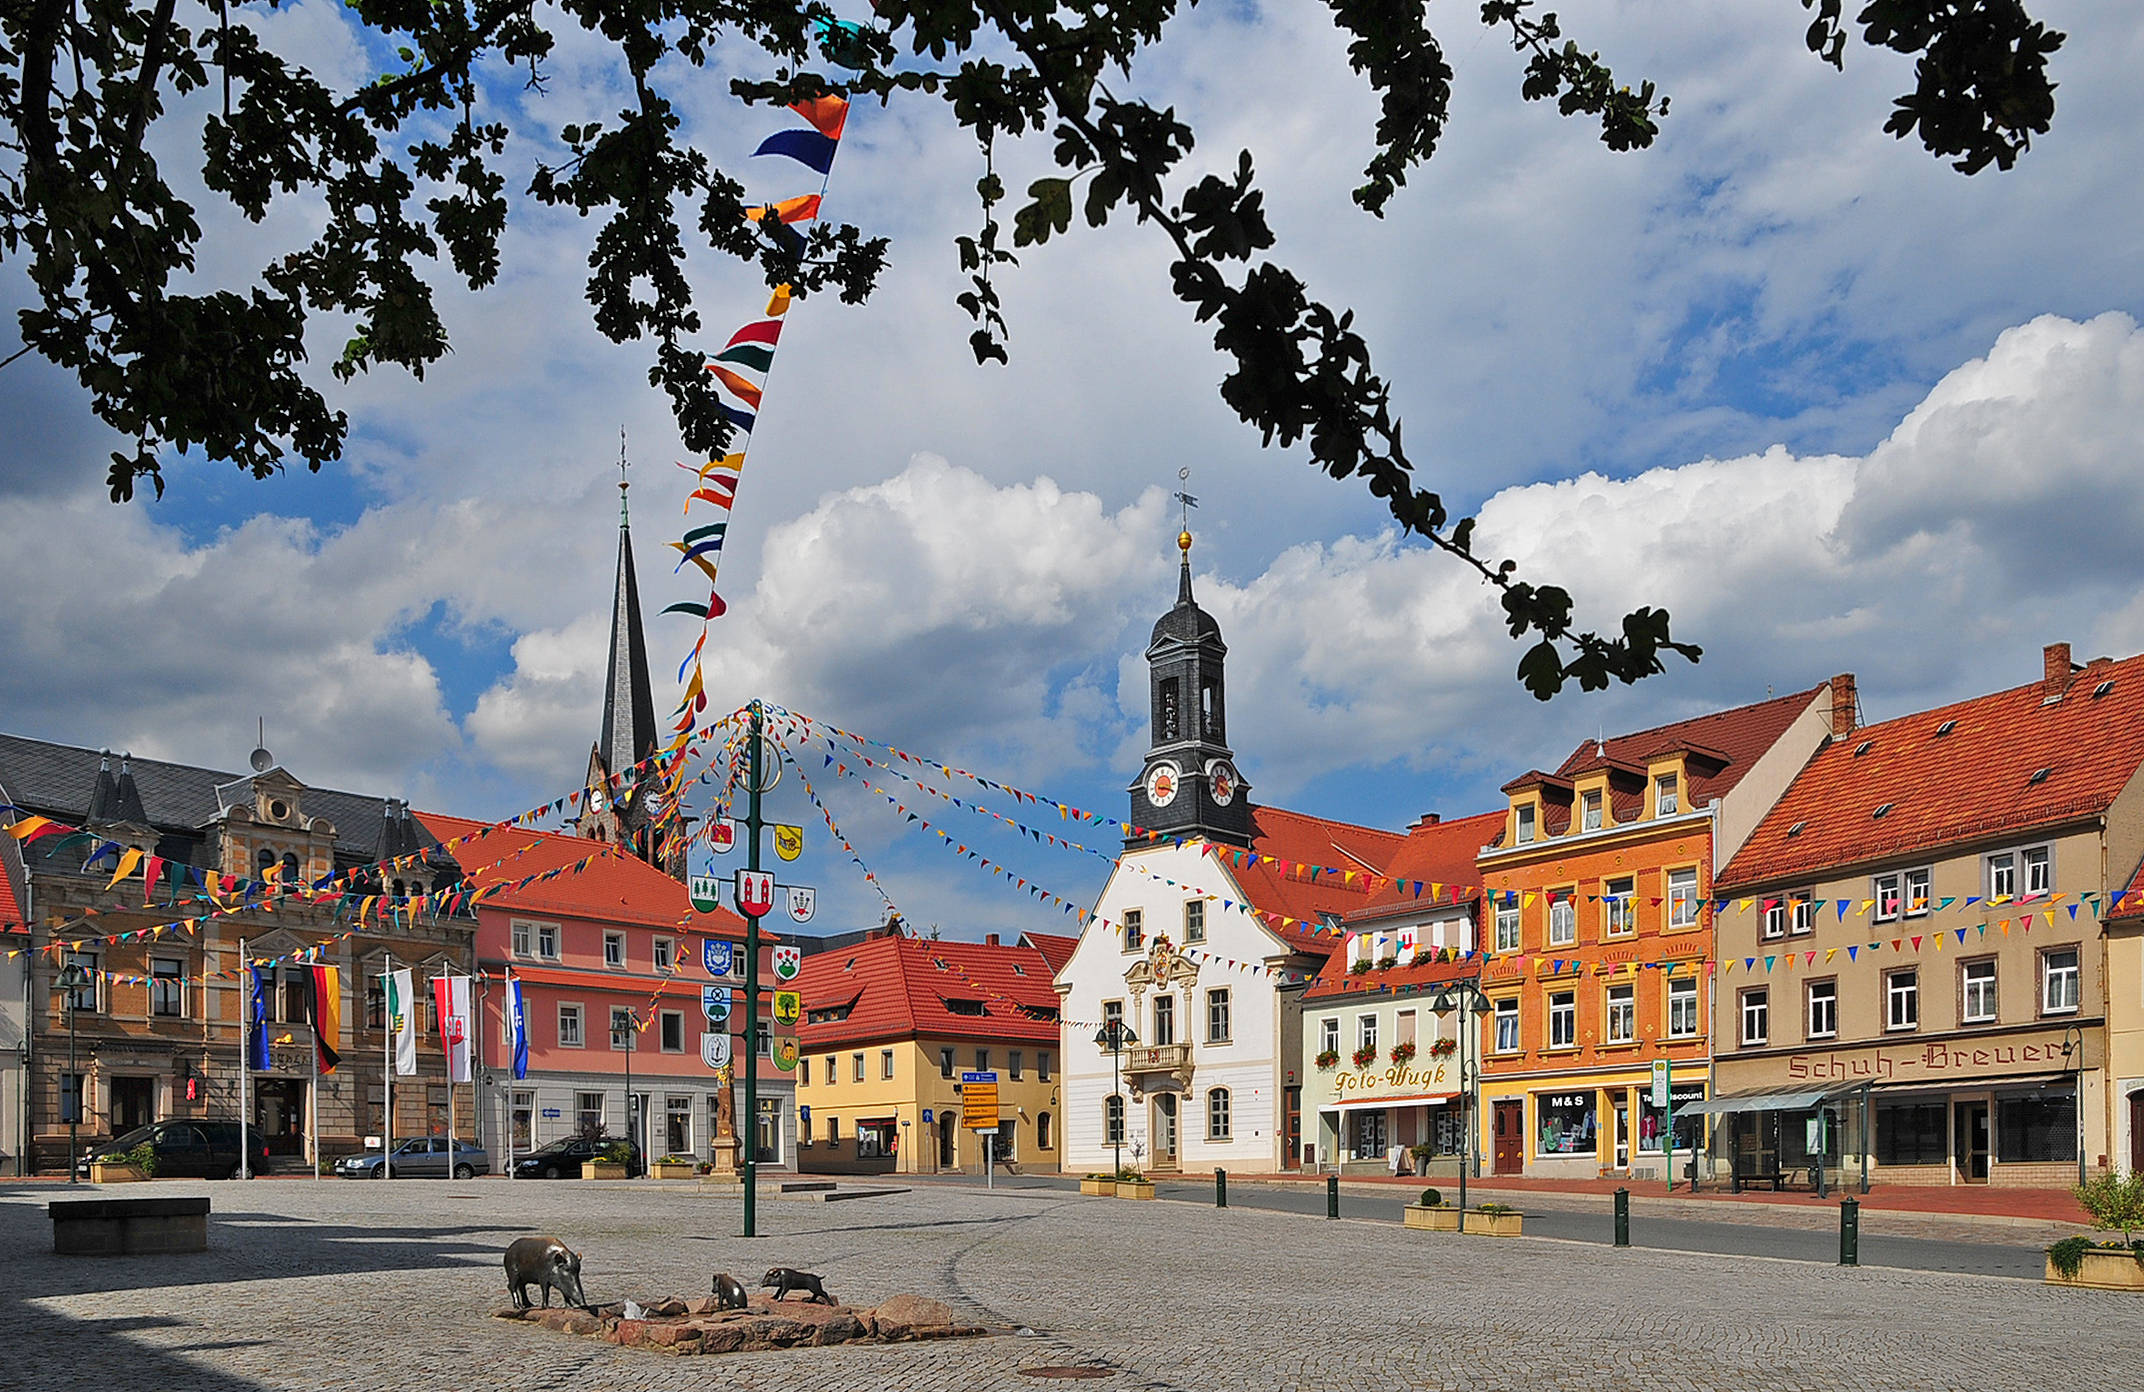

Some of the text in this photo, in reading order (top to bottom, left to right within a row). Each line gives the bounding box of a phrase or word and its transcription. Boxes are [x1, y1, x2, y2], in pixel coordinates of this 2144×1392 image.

[1334, 1063, 1446, 1091] Foto-Wugk
[1552, 1095, 1584, 1107] M & S
